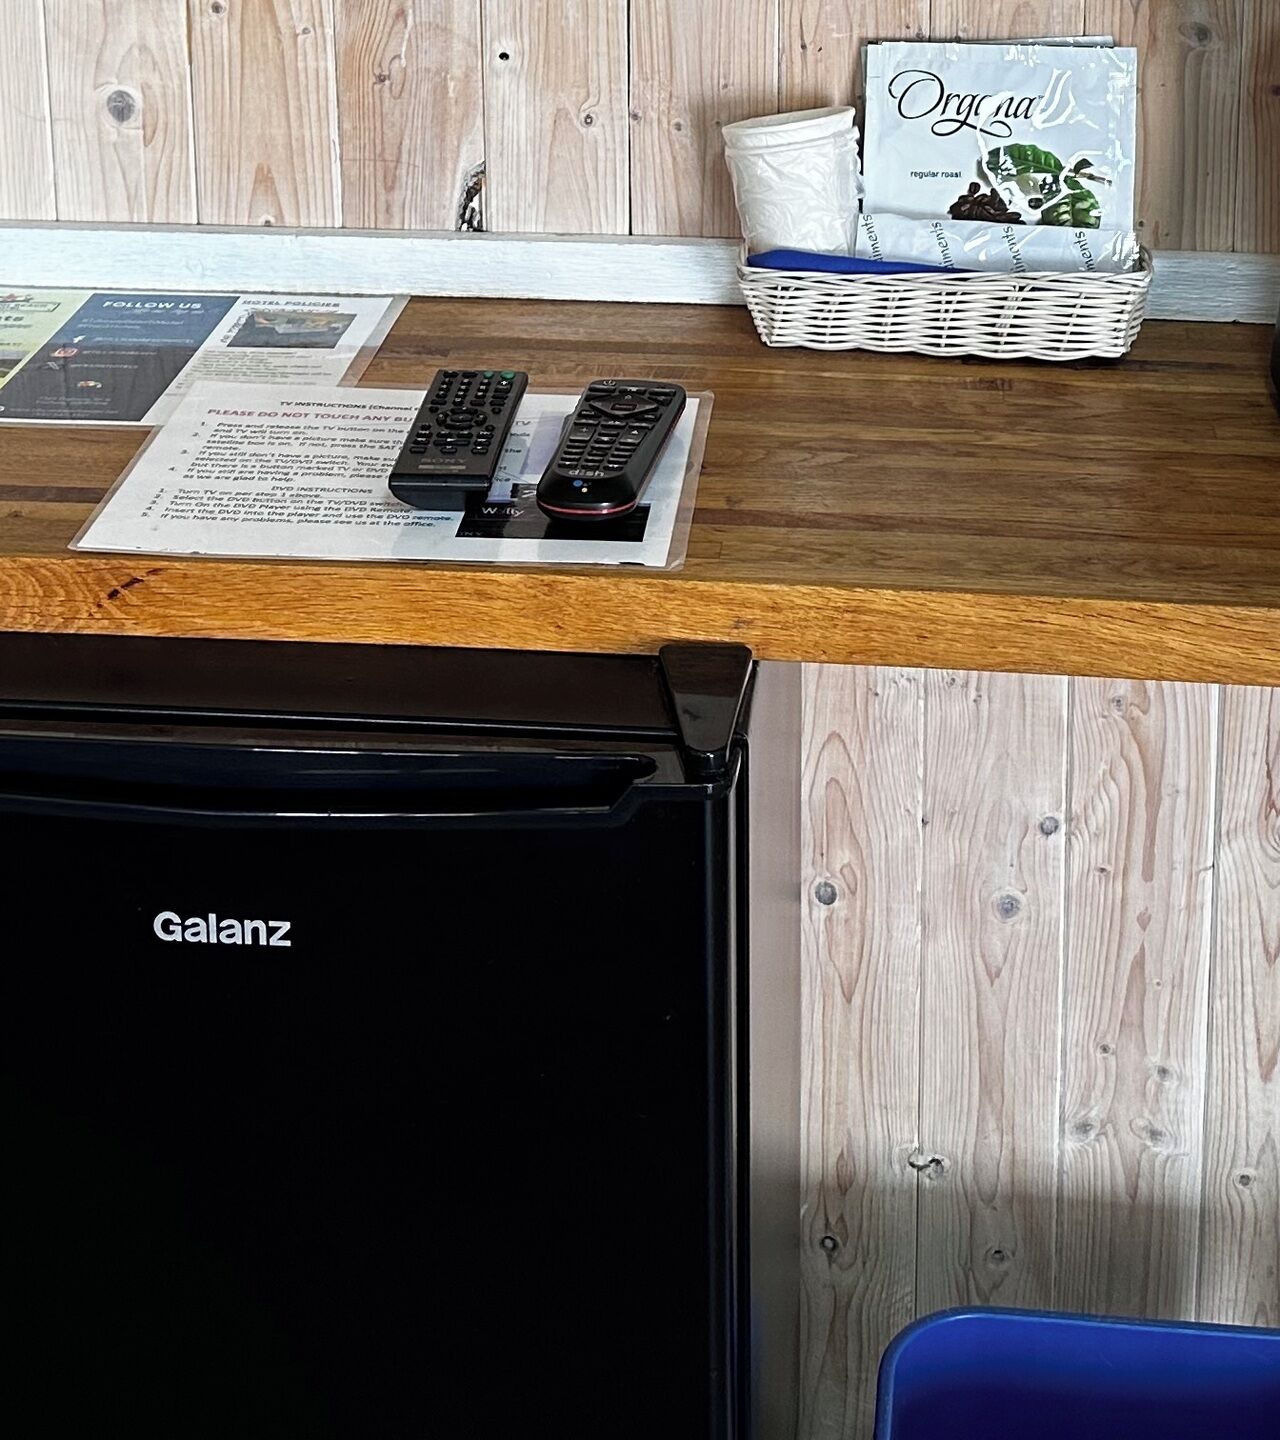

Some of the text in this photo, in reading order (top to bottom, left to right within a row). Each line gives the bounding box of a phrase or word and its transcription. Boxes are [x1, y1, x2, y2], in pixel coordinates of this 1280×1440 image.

[910, 169, 940, 179] regular
[102, 301, 175, 309] FOLLOW
[568, 468, 606, 478] dish
[153, 911, 291, 947] Galanz
